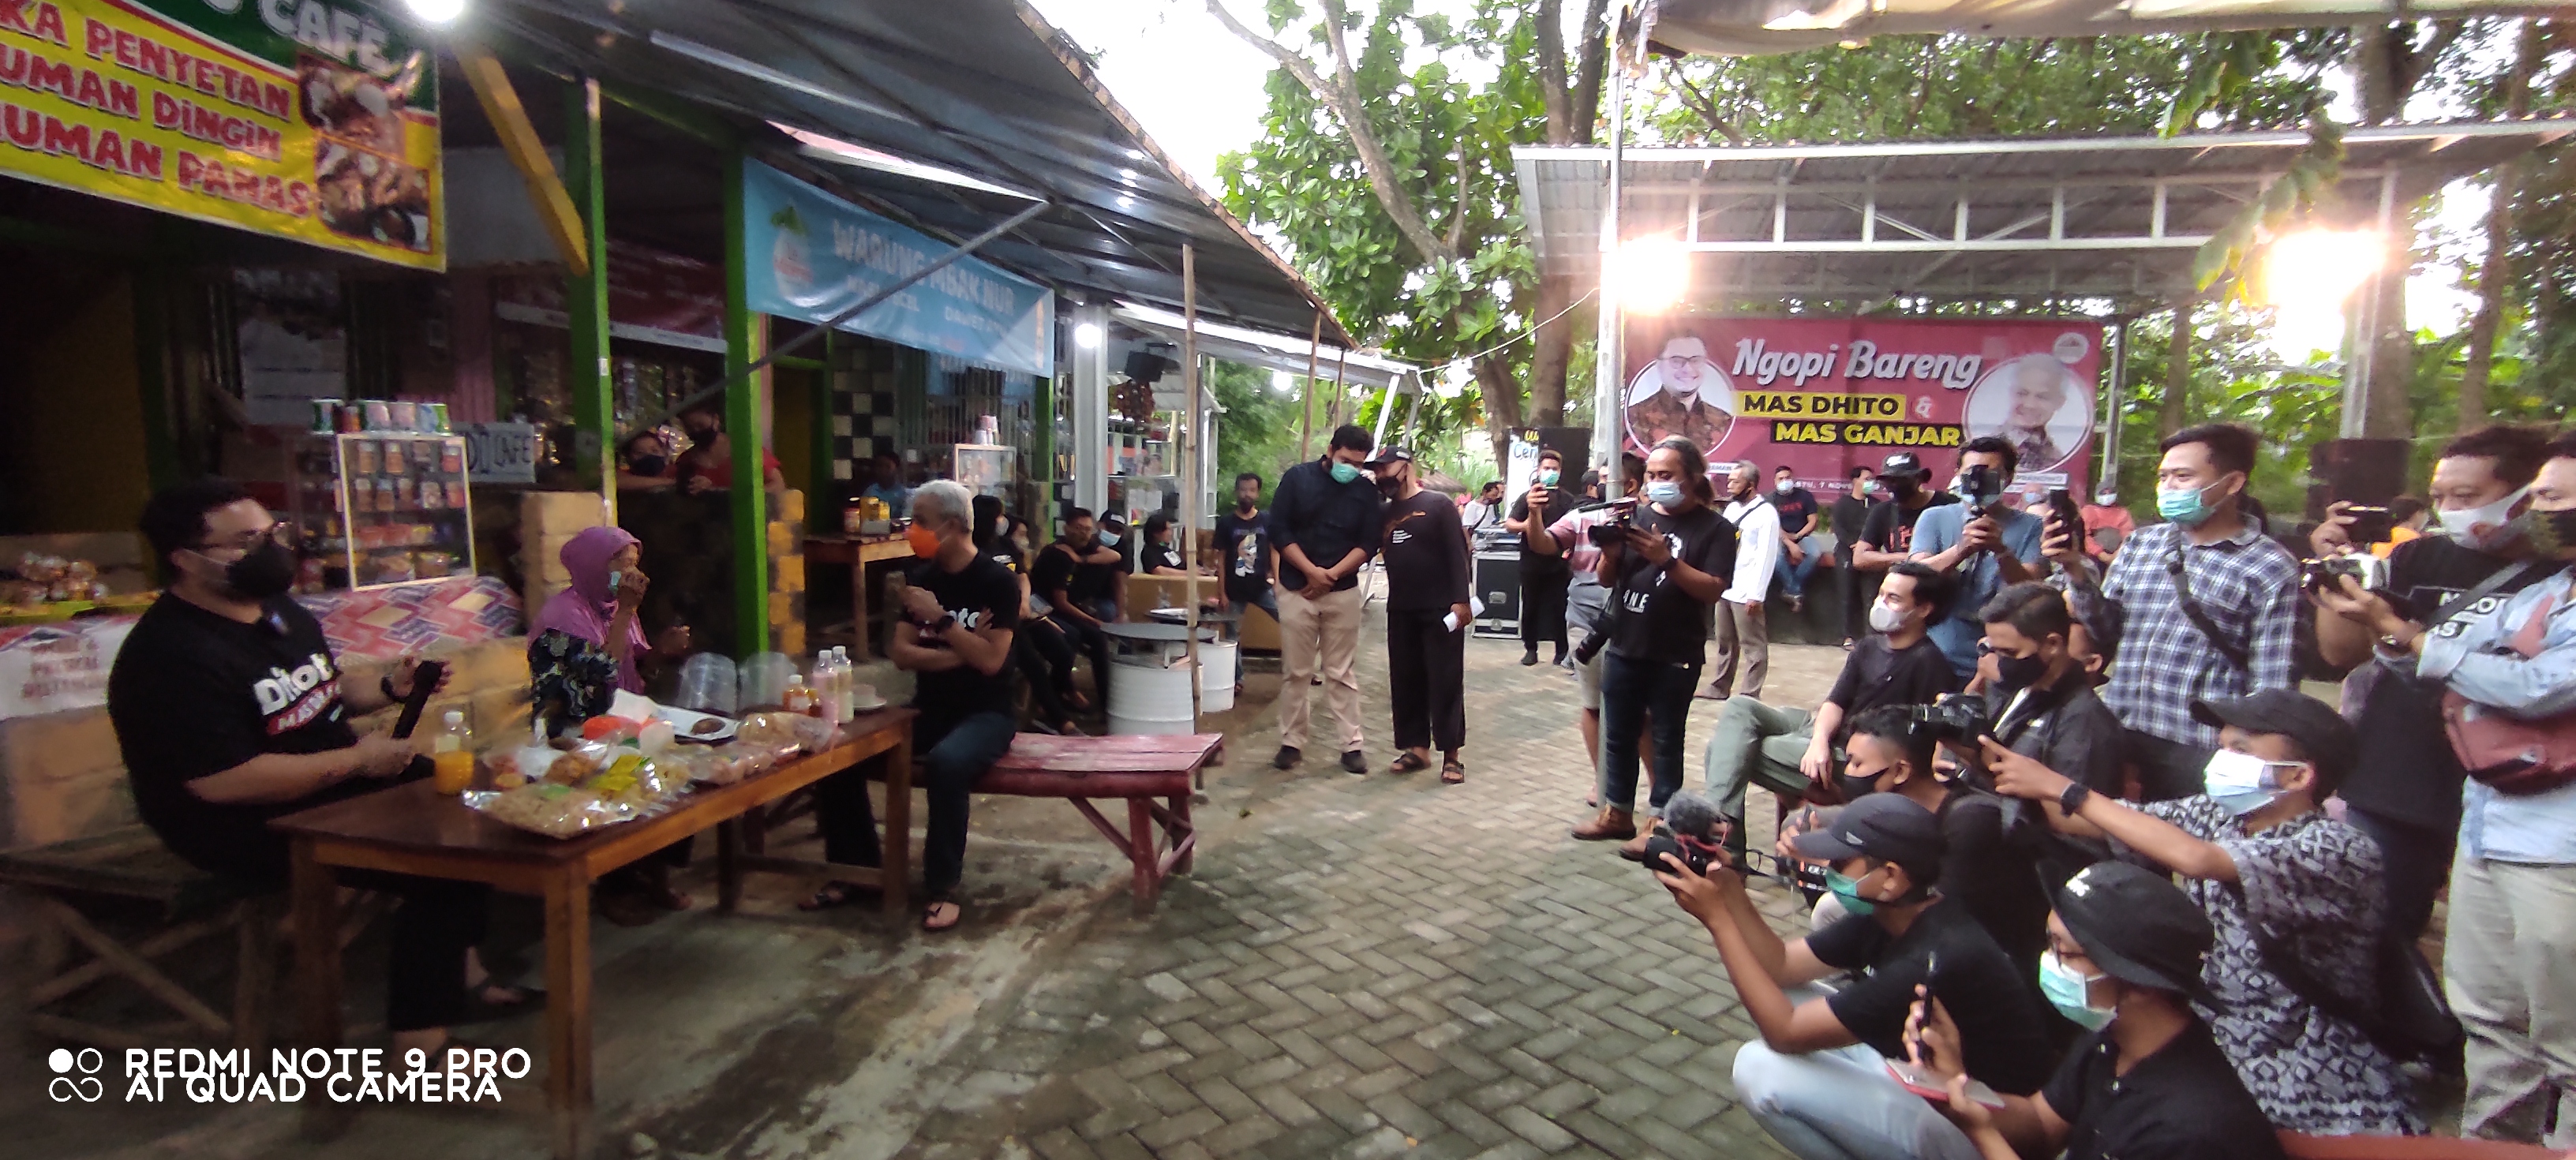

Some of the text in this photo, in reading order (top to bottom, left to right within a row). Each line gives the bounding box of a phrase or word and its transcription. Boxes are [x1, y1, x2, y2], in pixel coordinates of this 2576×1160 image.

[84, 17, 291, 122] PENYETAN
[178, 149, 312, 218] PANAS
[1732, 339, 1983, 390] Ngopi Bareng
[1743, 394, 1803, 413] MAS
[1811, 395, 1899, 416] DHITO
[1775, 422, 1961, 447] MAS GANJAR
